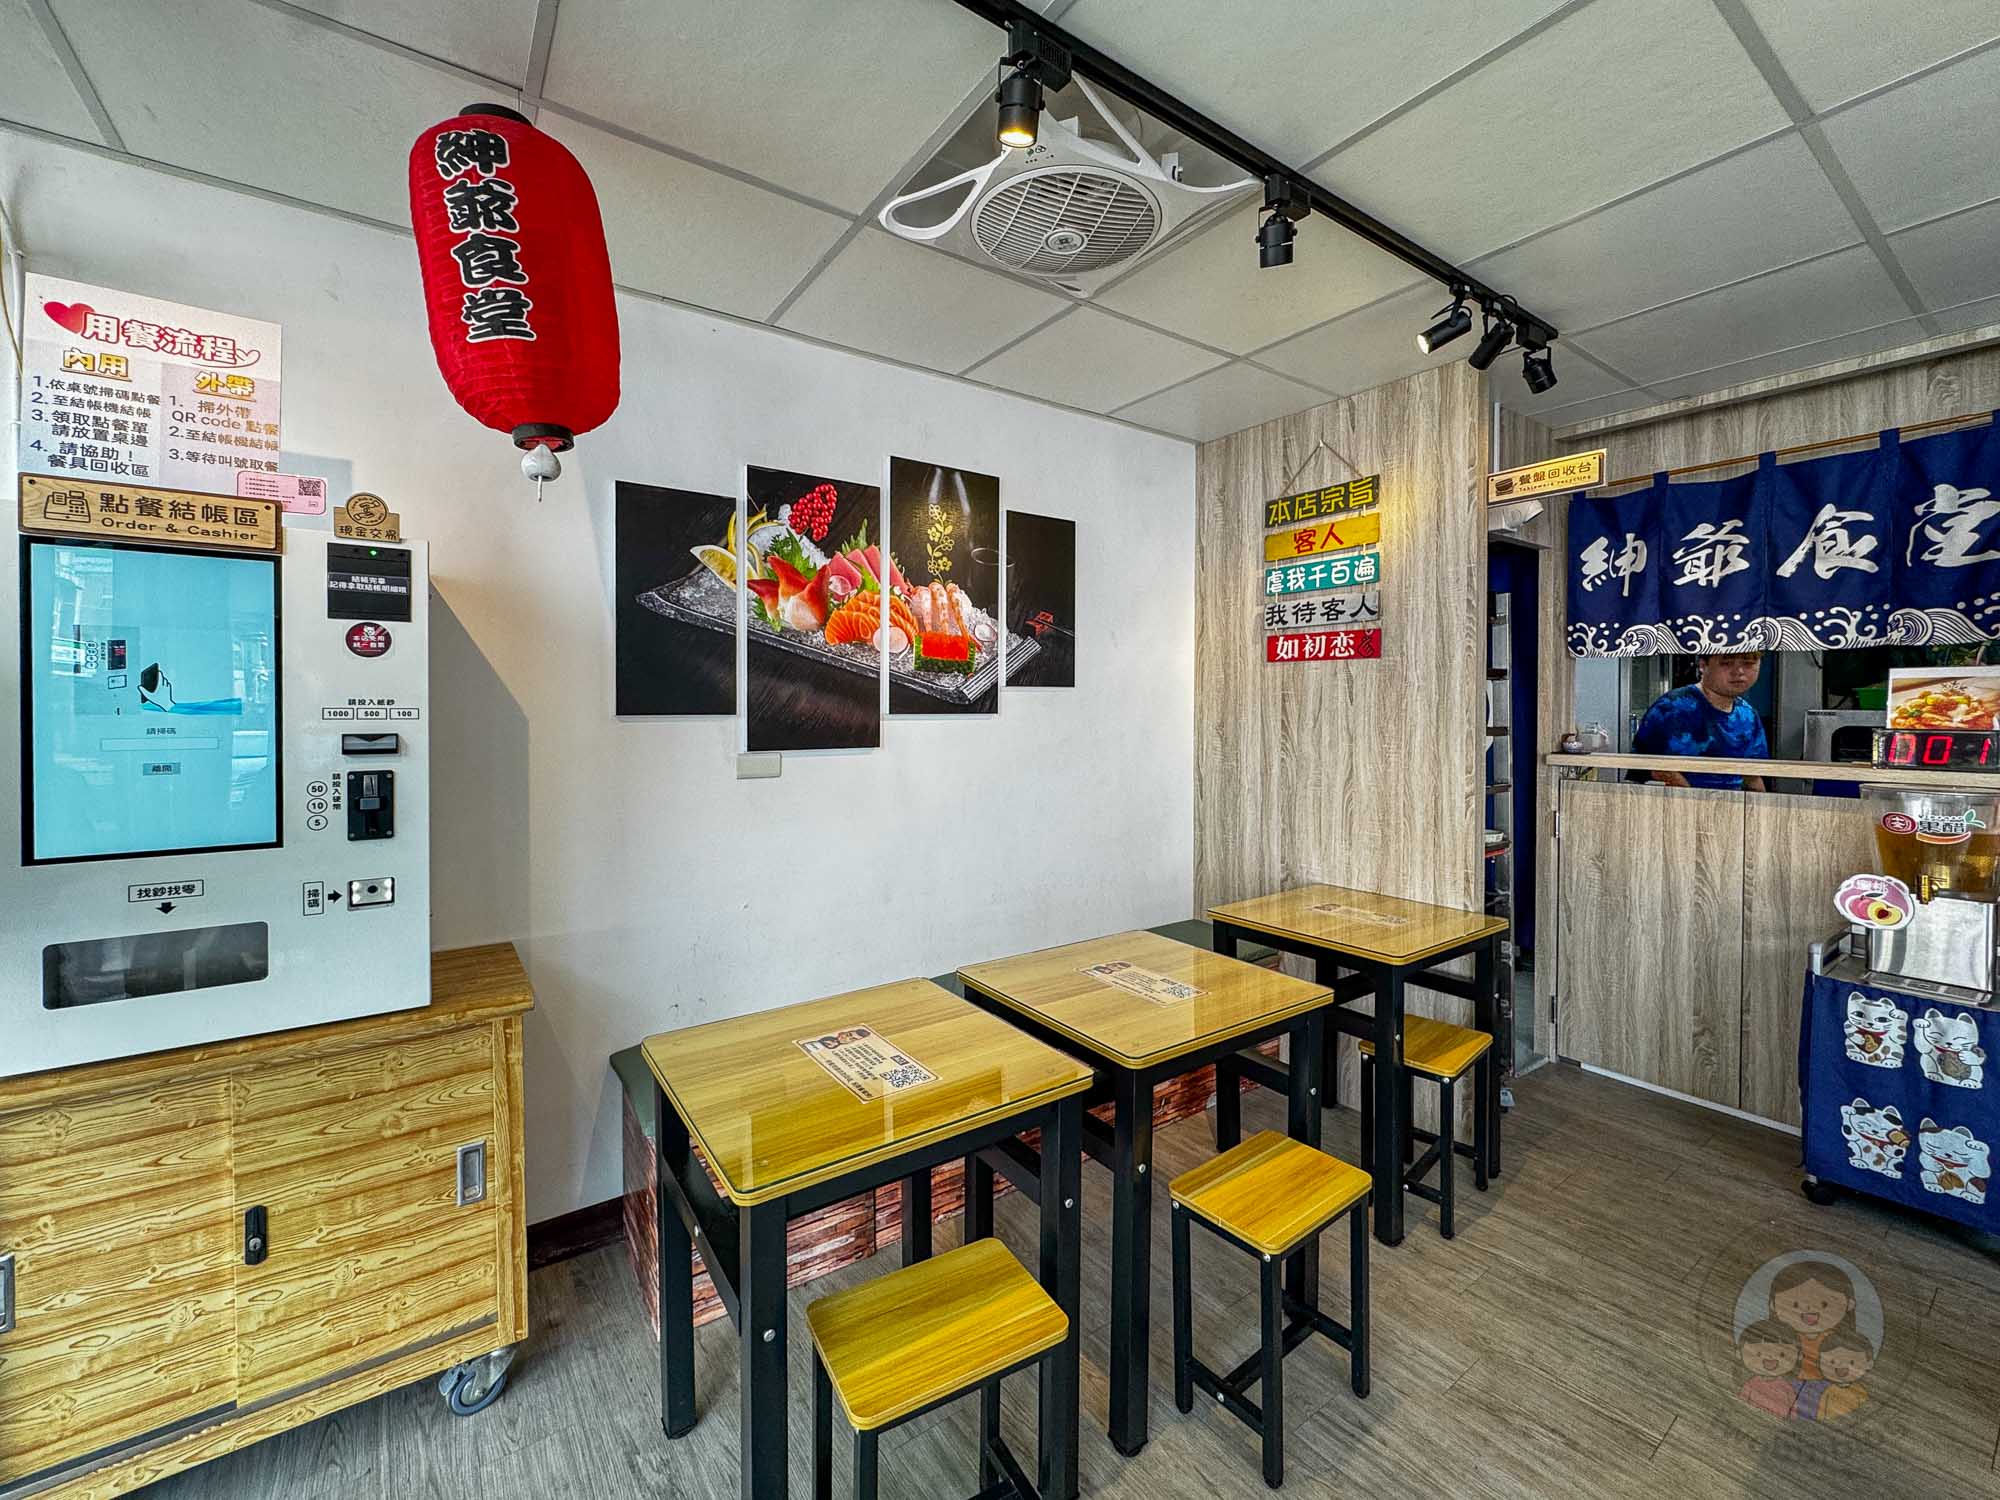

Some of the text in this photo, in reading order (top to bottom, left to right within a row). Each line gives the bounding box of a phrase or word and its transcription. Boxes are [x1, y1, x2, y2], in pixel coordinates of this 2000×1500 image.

[81, 309, 238, 366] 用餐流程
[195, 371, 256, 396] 外帶
[171, 410, 197, 424] QR
[200, 416, 241, 430] code
[51, 423, 149, 448] 請放置桌邊
[47, 453, 150, 478] 餐具回收區
[99, 492, 260, 527] 點餐結帳區
[1268, 476, 1374, 526] 本店宗旨
[100, 516, 259, 541] Order & Cashier
[1293, 523, 1345, 555] 客人
[1579, 483, 2000, 597] 紳爺食堂
[1266, 556, 1375, 594] 虐我千百遍
[1265, 595, 1378, 627] 我待客人
[1275, 632, 1356, 661] 如初恋
[311, 785, 323, 793] 50
[311, 802, 323, 810] 10
[1918, 820, 1967, 833] 果醋
